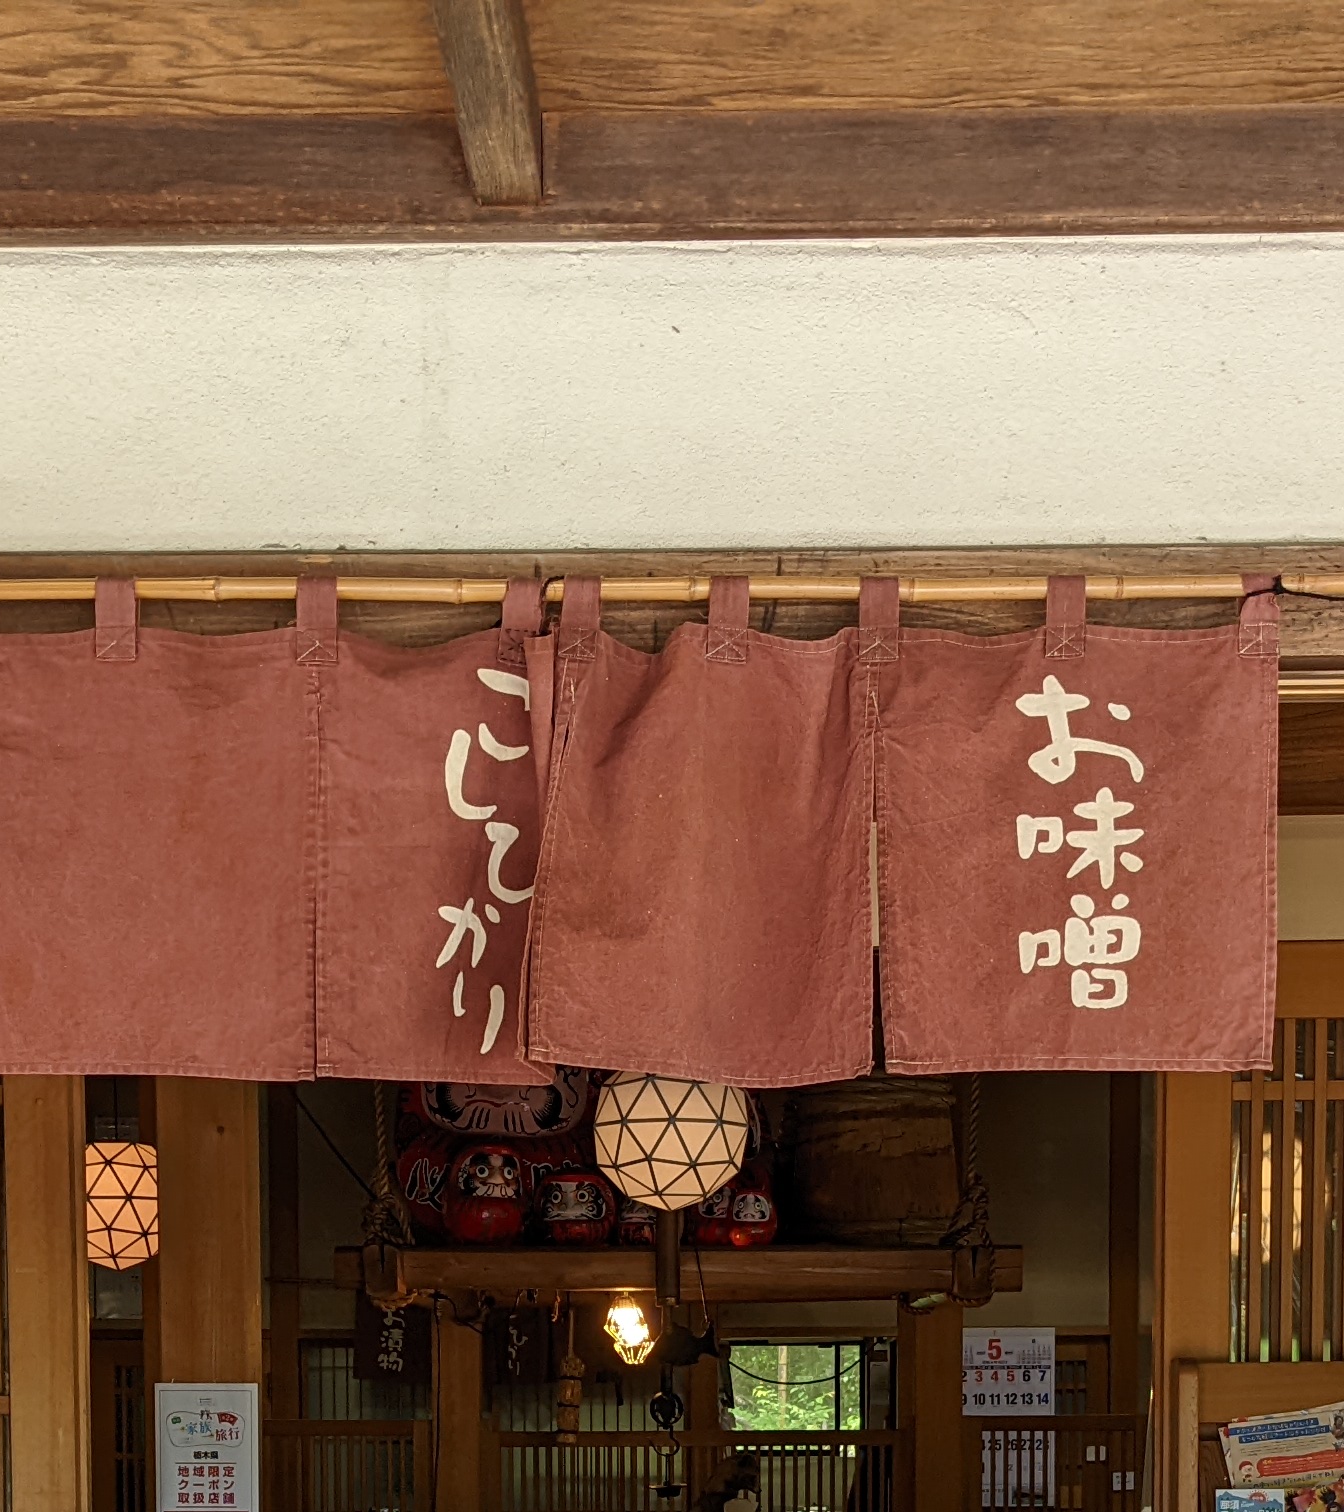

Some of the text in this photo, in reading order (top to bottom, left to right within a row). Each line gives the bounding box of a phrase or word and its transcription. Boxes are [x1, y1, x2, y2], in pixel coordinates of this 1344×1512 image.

[1014, 673, 1145, 1011] お味噌
[987, 1338, 1002, 1361] 5
[974, 1370, 984, 1383] 3
[990, 1370, 999, 1383] 4
[1006, 1370, 1015, 1383] 5
[1022, 1370, 1031, 1383] 6
[1038, 1370, 1047, 1383] 7
[972, 1393, 986, 1405] 10
[989, 1393, 1001, 1405] 11
[1004, 1393, 1018, 1405] 12
[1020, 1393, 1034, 1405] 13
[1036, 1393, 1049, 1405] 14
[177, 1465, 235, 1478] 地域限定
[177, 1479, 235, 1490] クーポン
[177, 1492, 235, 1504] 取扱店舗
